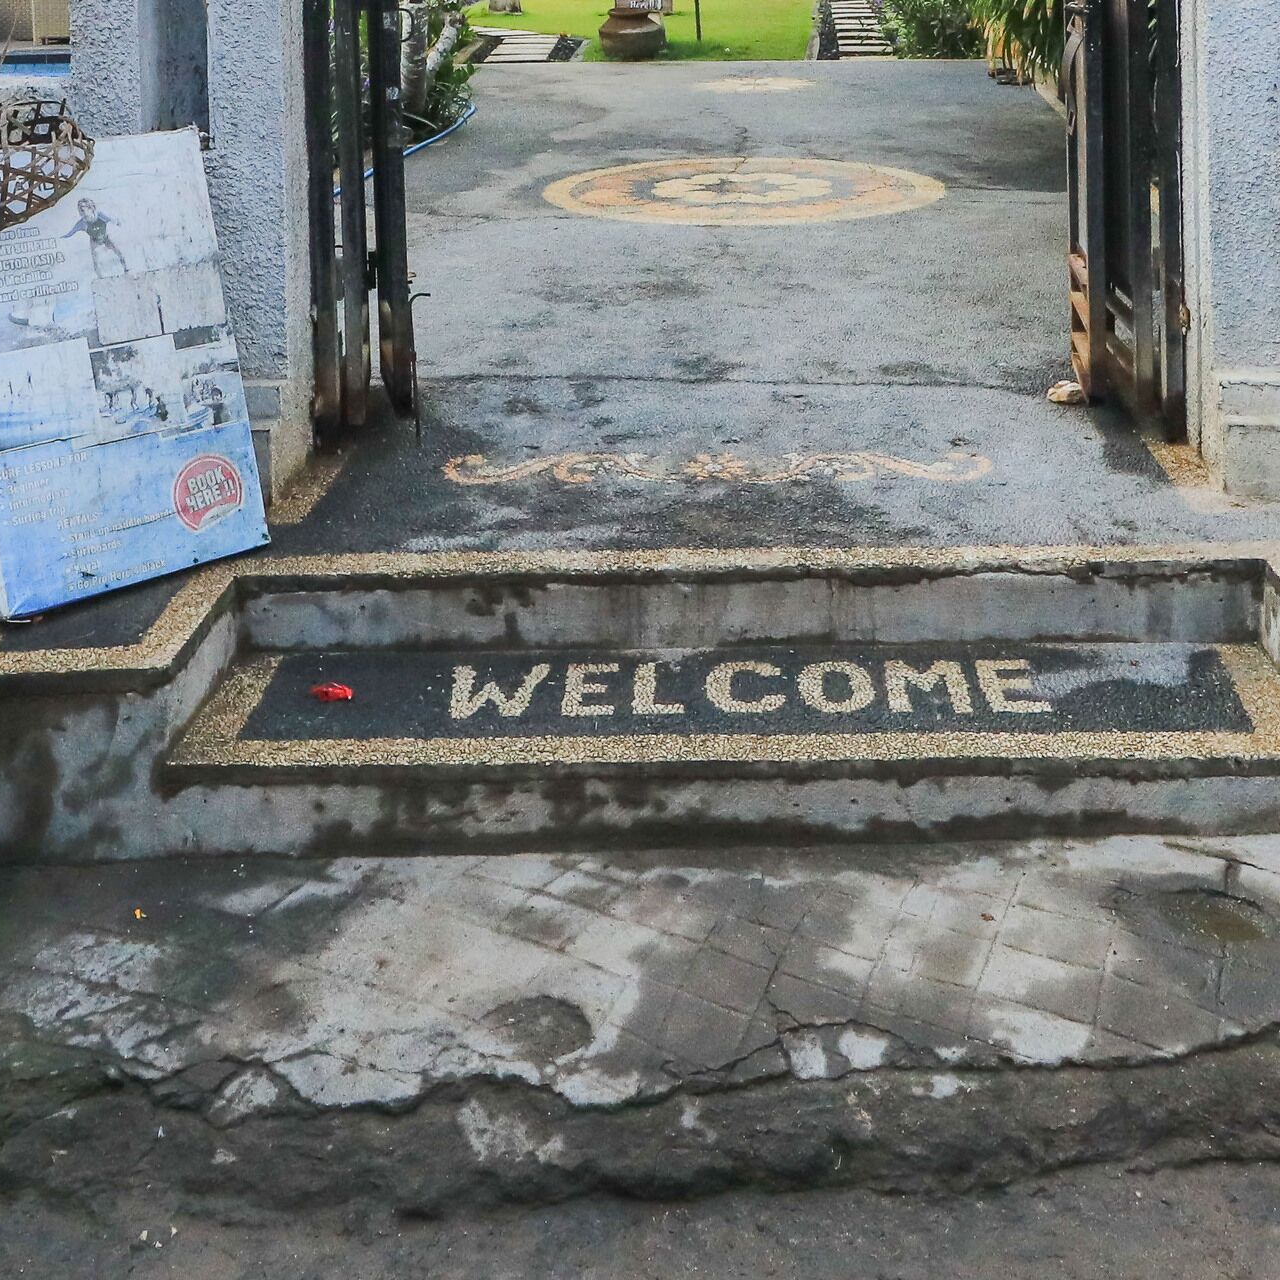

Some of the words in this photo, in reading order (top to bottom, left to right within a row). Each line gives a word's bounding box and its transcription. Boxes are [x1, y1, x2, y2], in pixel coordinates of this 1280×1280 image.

[55, 251, 66, 263] &
[5, 269, 53, 287] Medallion
[20, 280, 79, 300] certification
[187, 465, 226, 495] BOOK
[185, 484, 222, 514] HERE
[448, 659, 1053, 719] WELCOME
